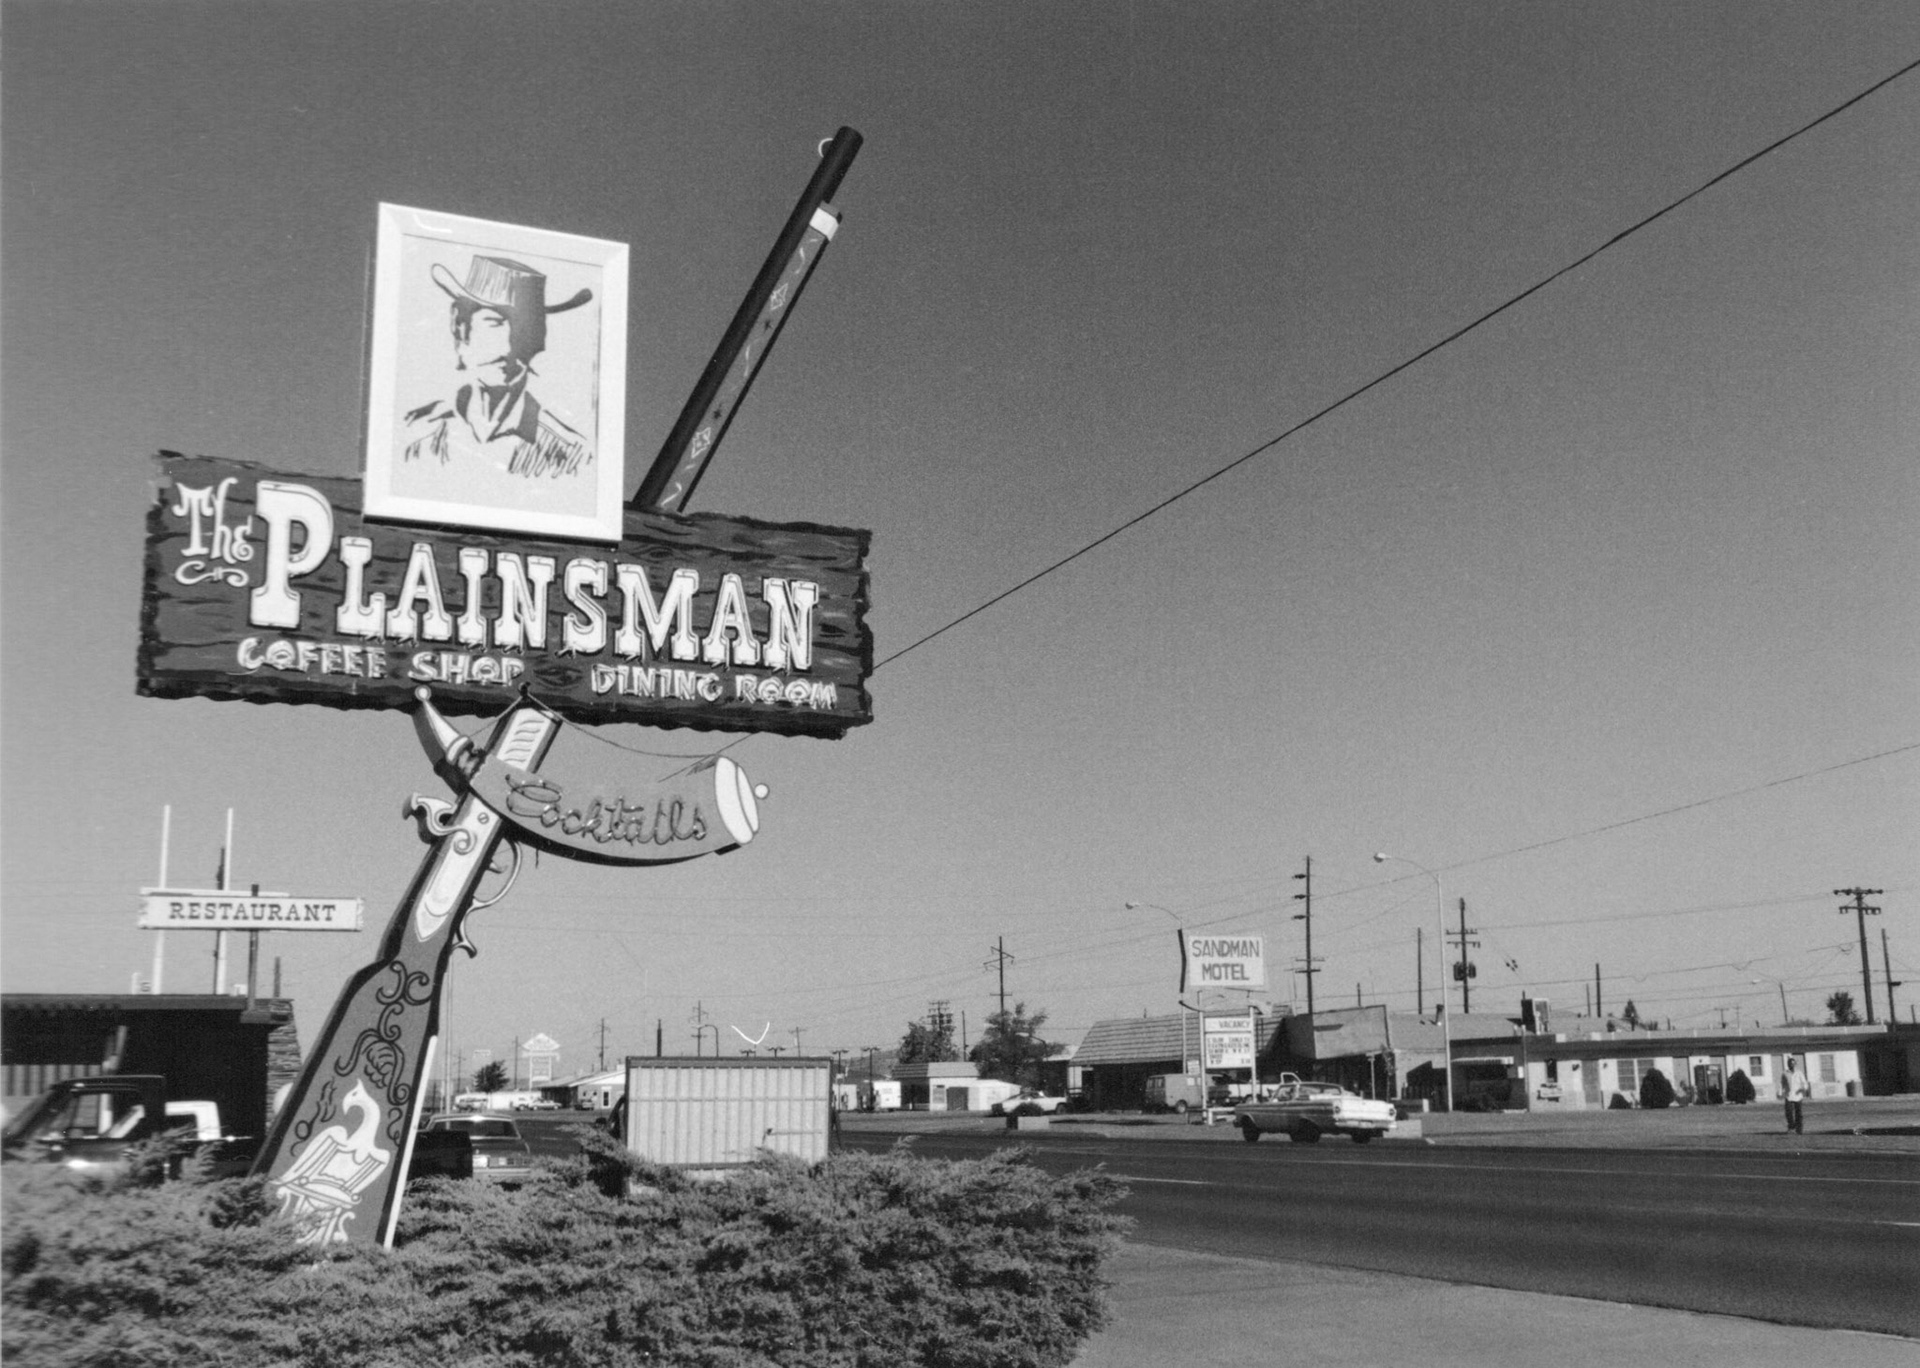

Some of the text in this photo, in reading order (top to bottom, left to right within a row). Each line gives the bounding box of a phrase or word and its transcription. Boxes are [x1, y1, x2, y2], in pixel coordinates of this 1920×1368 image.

[172, 476, 819, 672] The PLAINSMAN
[237, 637, 525, 687] COFFEE SHOP
[591, 663, 838, 710] DINING ROOM
[505, 774, 707, 846] Cocktails
[169, 902, 337, 922] RESTAURANT
[1192, 939, 1260, 958] SANDMAN
[1202, 963, 1250, 981] MOTEL
[1218, 1020, 1250, 1029] VACANCY
